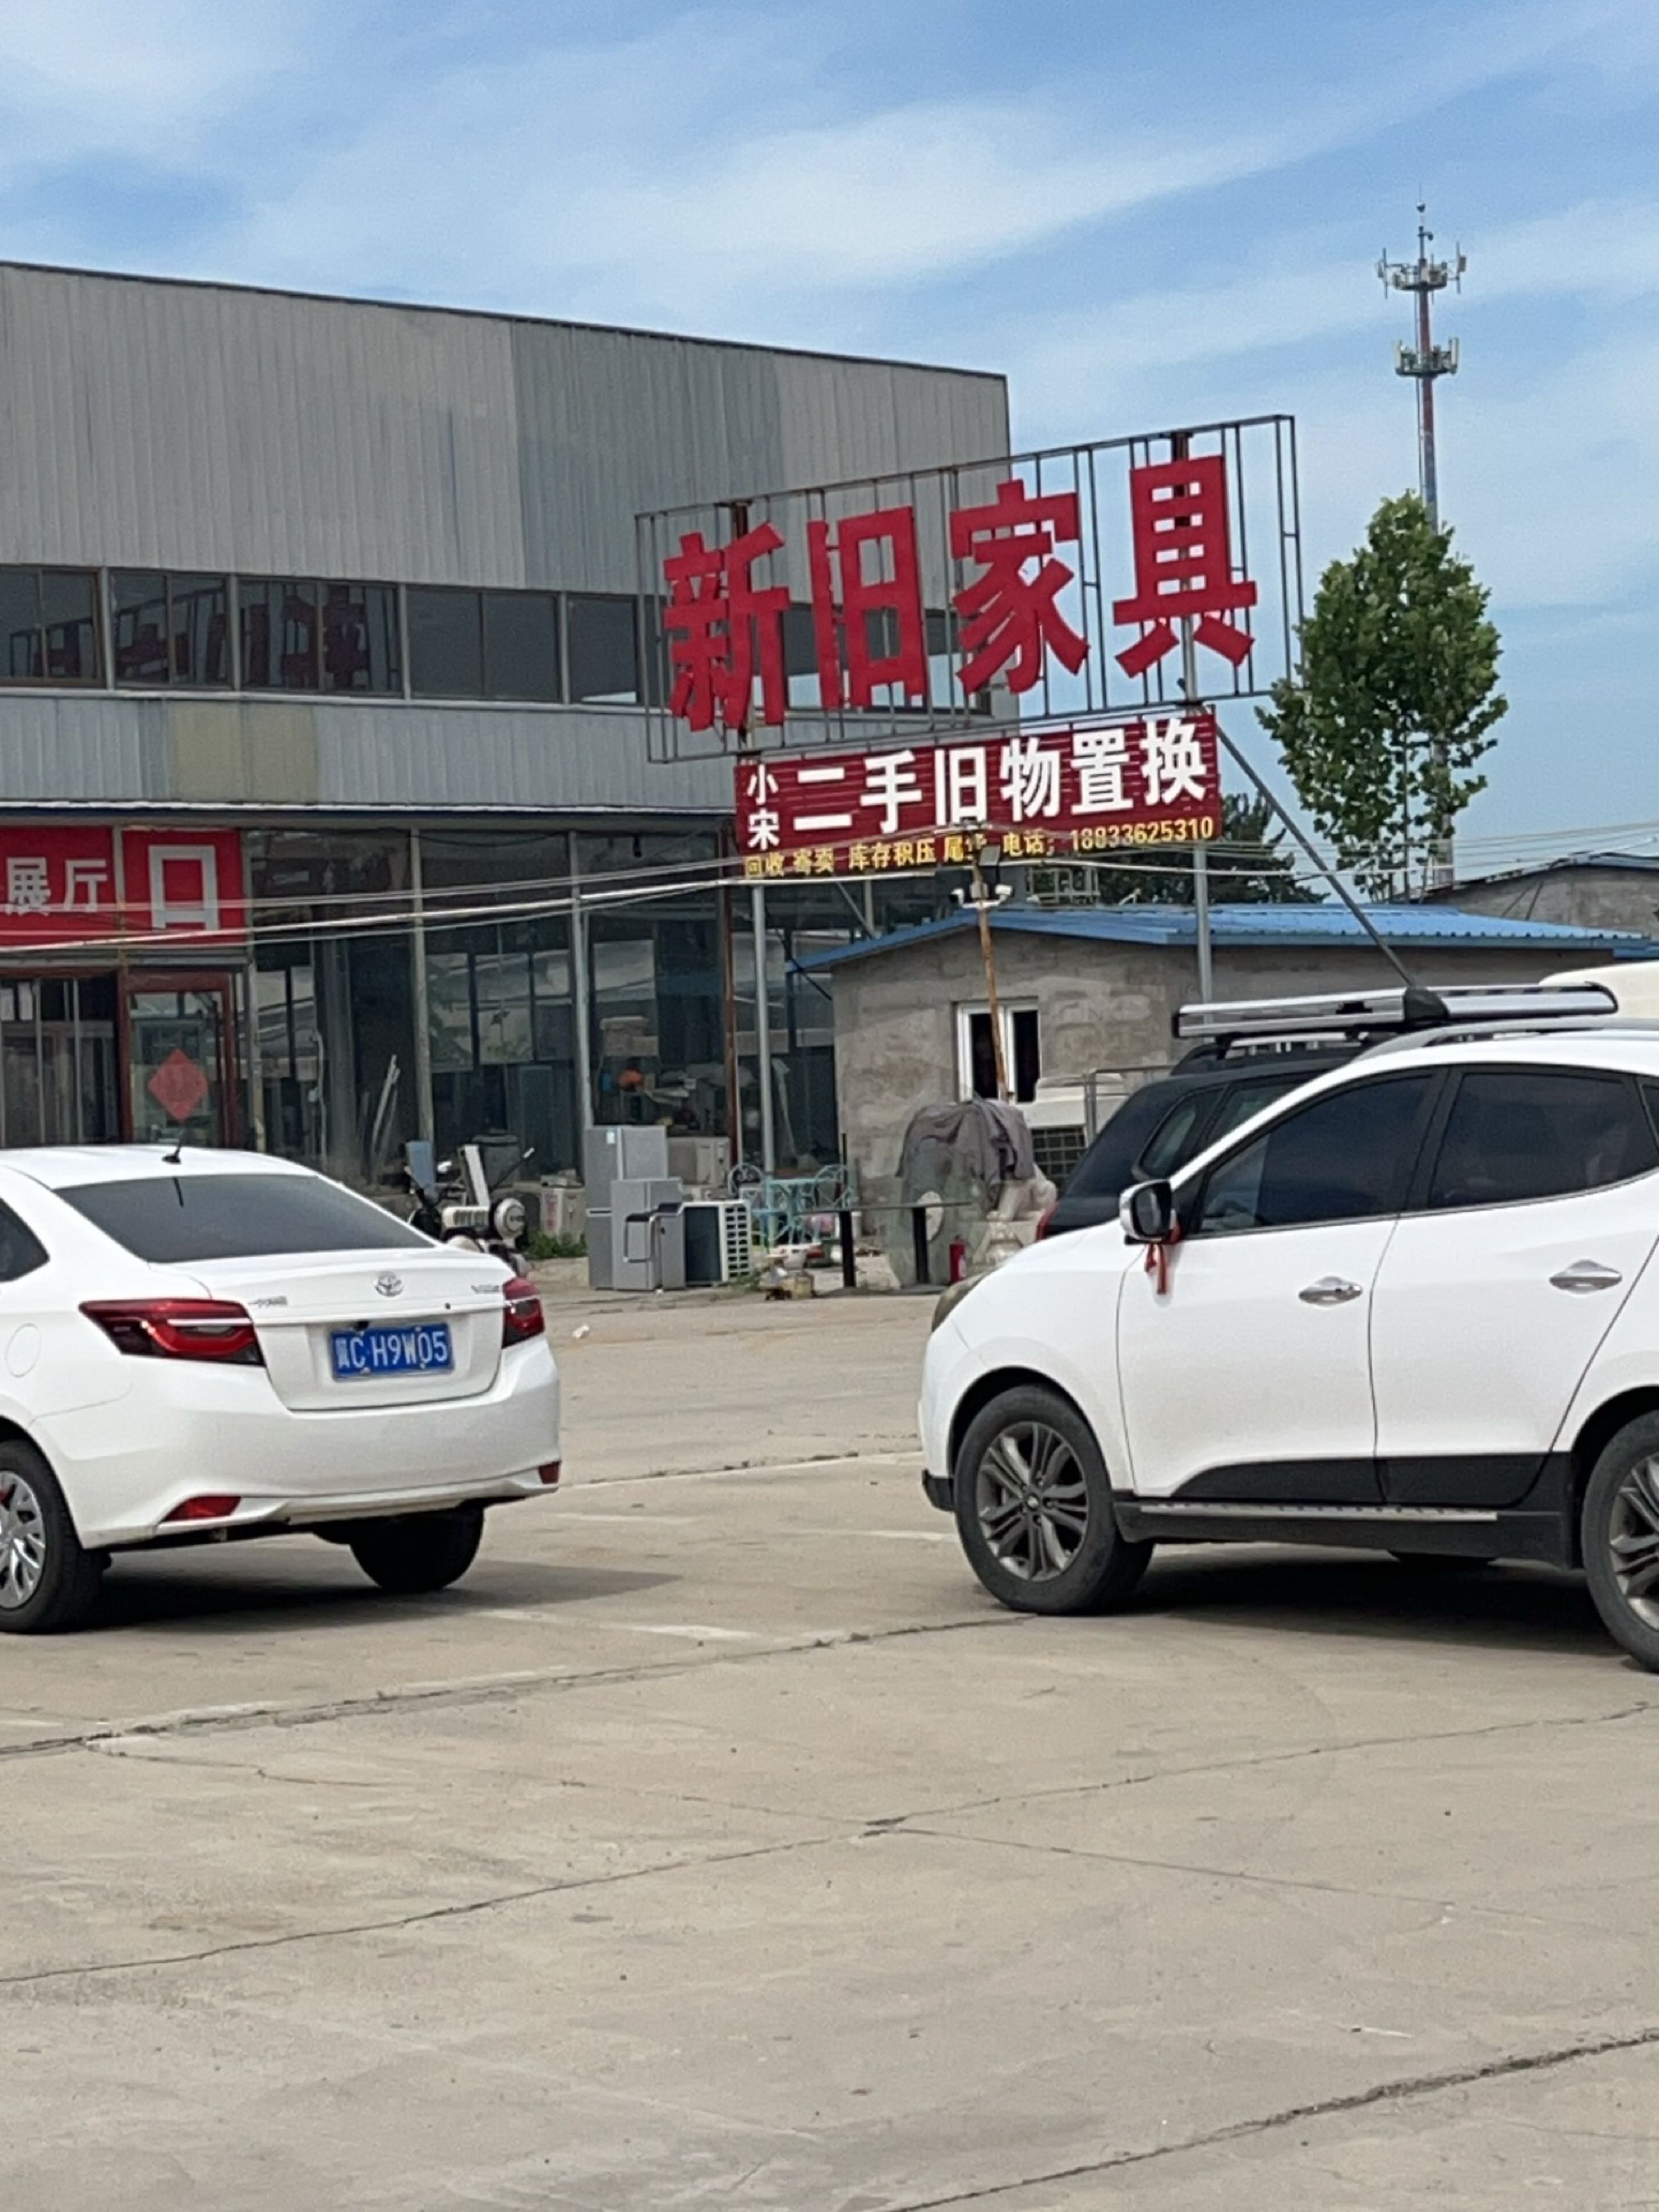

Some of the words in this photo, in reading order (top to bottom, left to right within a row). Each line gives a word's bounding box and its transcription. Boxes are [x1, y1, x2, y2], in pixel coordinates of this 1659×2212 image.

[663, 454, 1256, 732] 新旧家具
[746, 764, 780, 851] 小宋
[793, 716, 1207, 835] 二手旧物置换
[5, 857, 108, 916] 展厅
[849, 837, 936, 871] 库存积压
[1070, 816, 1214, 852] 18833625310
